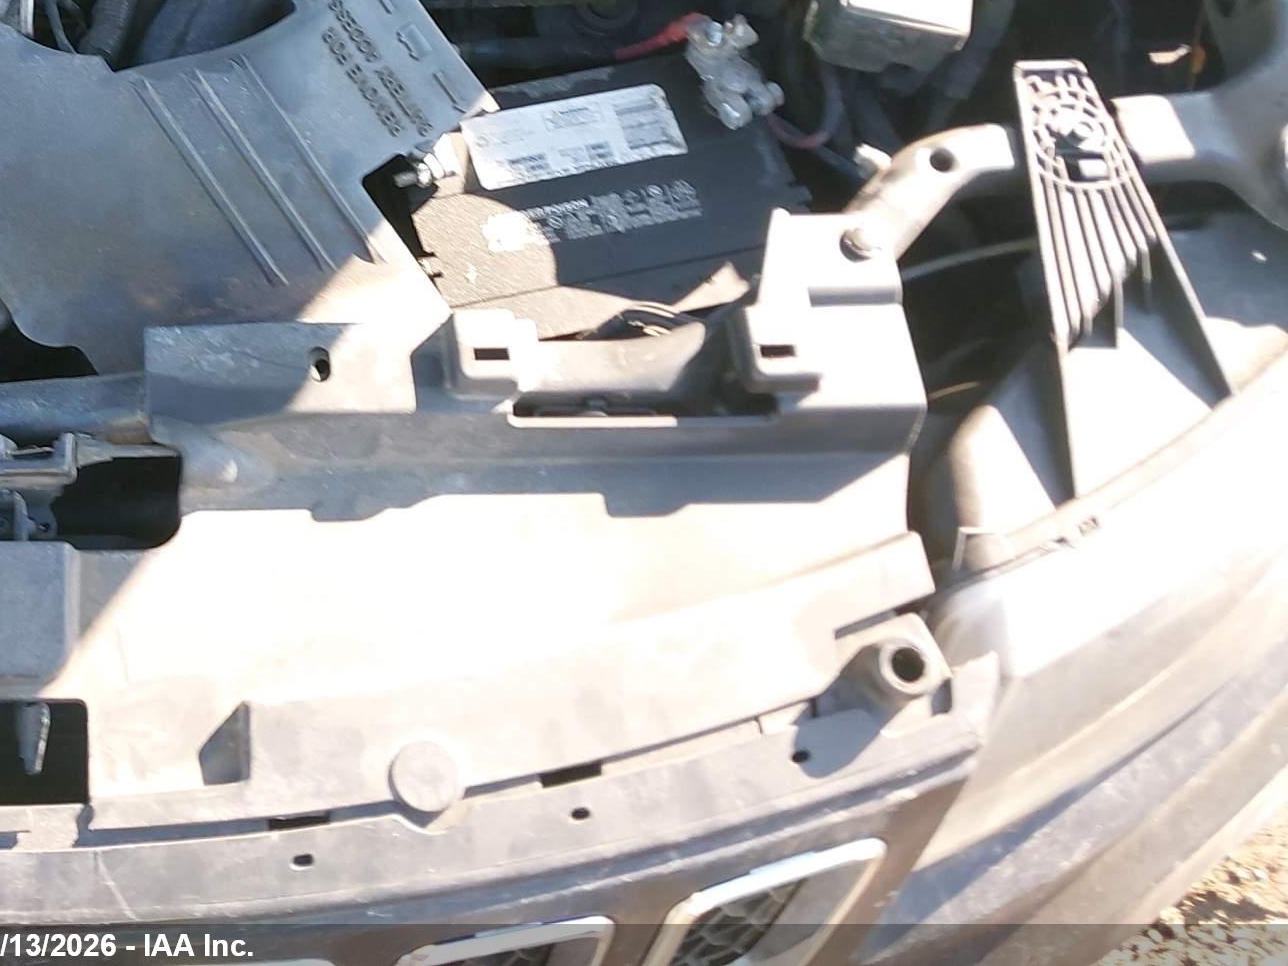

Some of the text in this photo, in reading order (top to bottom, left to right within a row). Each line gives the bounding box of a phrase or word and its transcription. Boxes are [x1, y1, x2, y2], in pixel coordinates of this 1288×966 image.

[322, 26, 404, 138] REMOVE FOR
[373, 65, 434, 138] BATTERY
